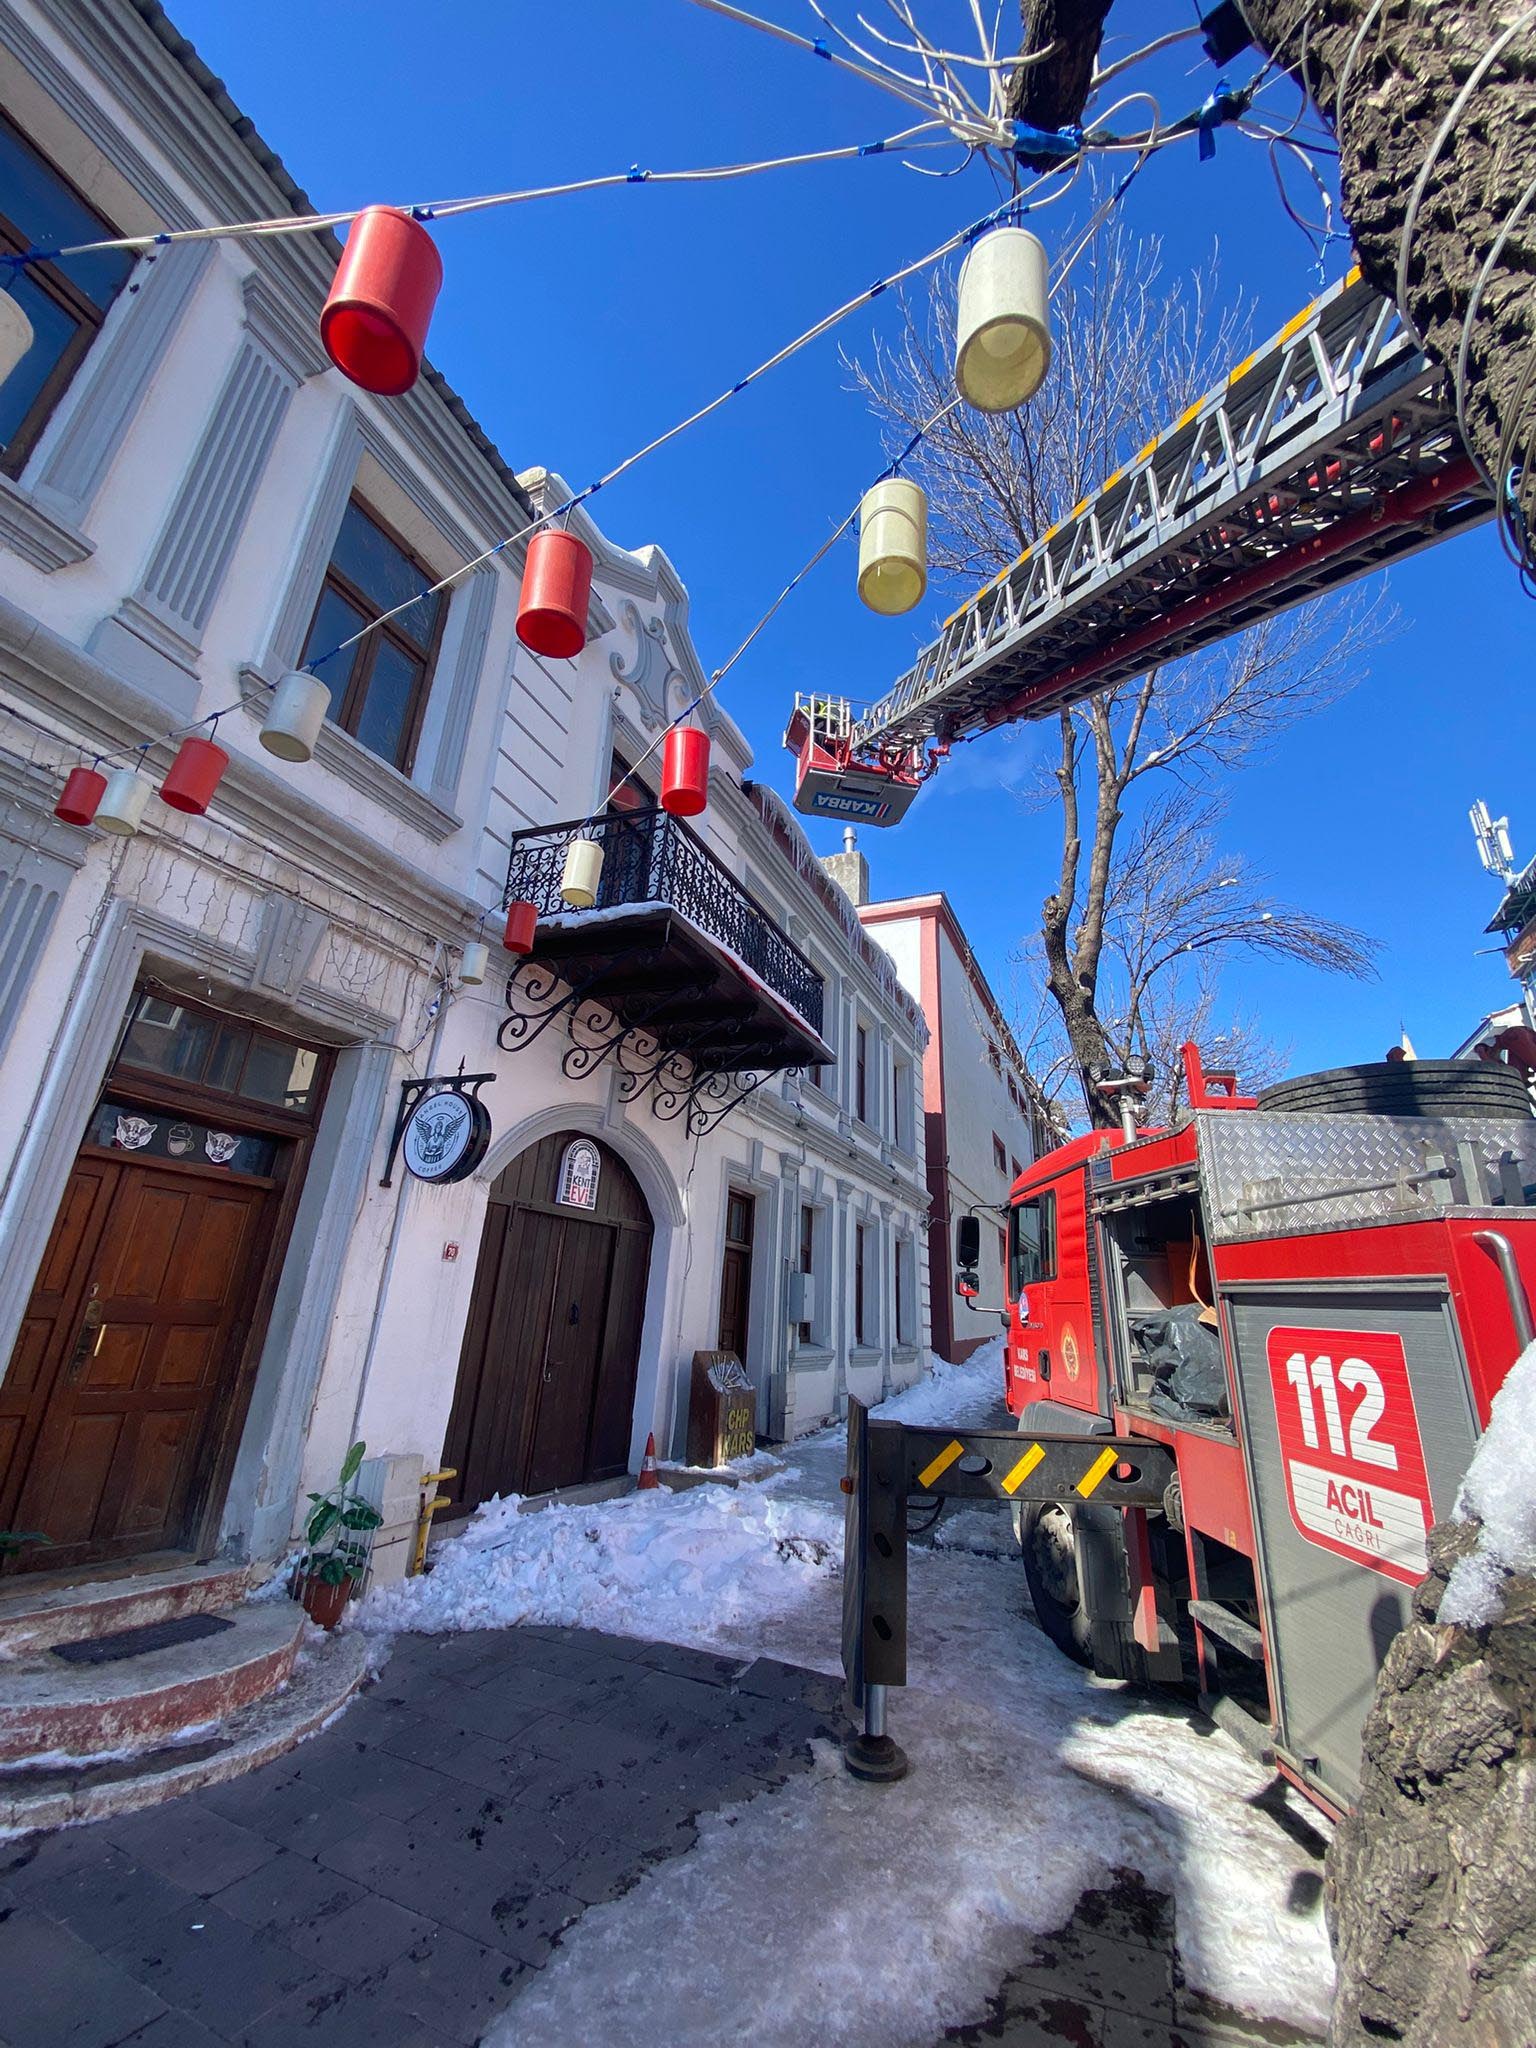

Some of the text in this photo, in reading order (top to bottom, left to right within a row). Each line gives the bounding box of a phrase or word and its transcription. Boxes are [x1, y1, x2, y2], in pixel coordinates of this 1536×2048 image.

[817, 794, 877, 815] KARBA
[420, 1101, 442, 1118] ANGEL
[418, 1164, 442, 1173] COFFEE
[572, 1175, 591, 1188] KENT
[728, 1408, 750, 1431] CHP
[1286, 1352, 1399, 1472] 112
[721, 1431, 753, 1458] KARS
